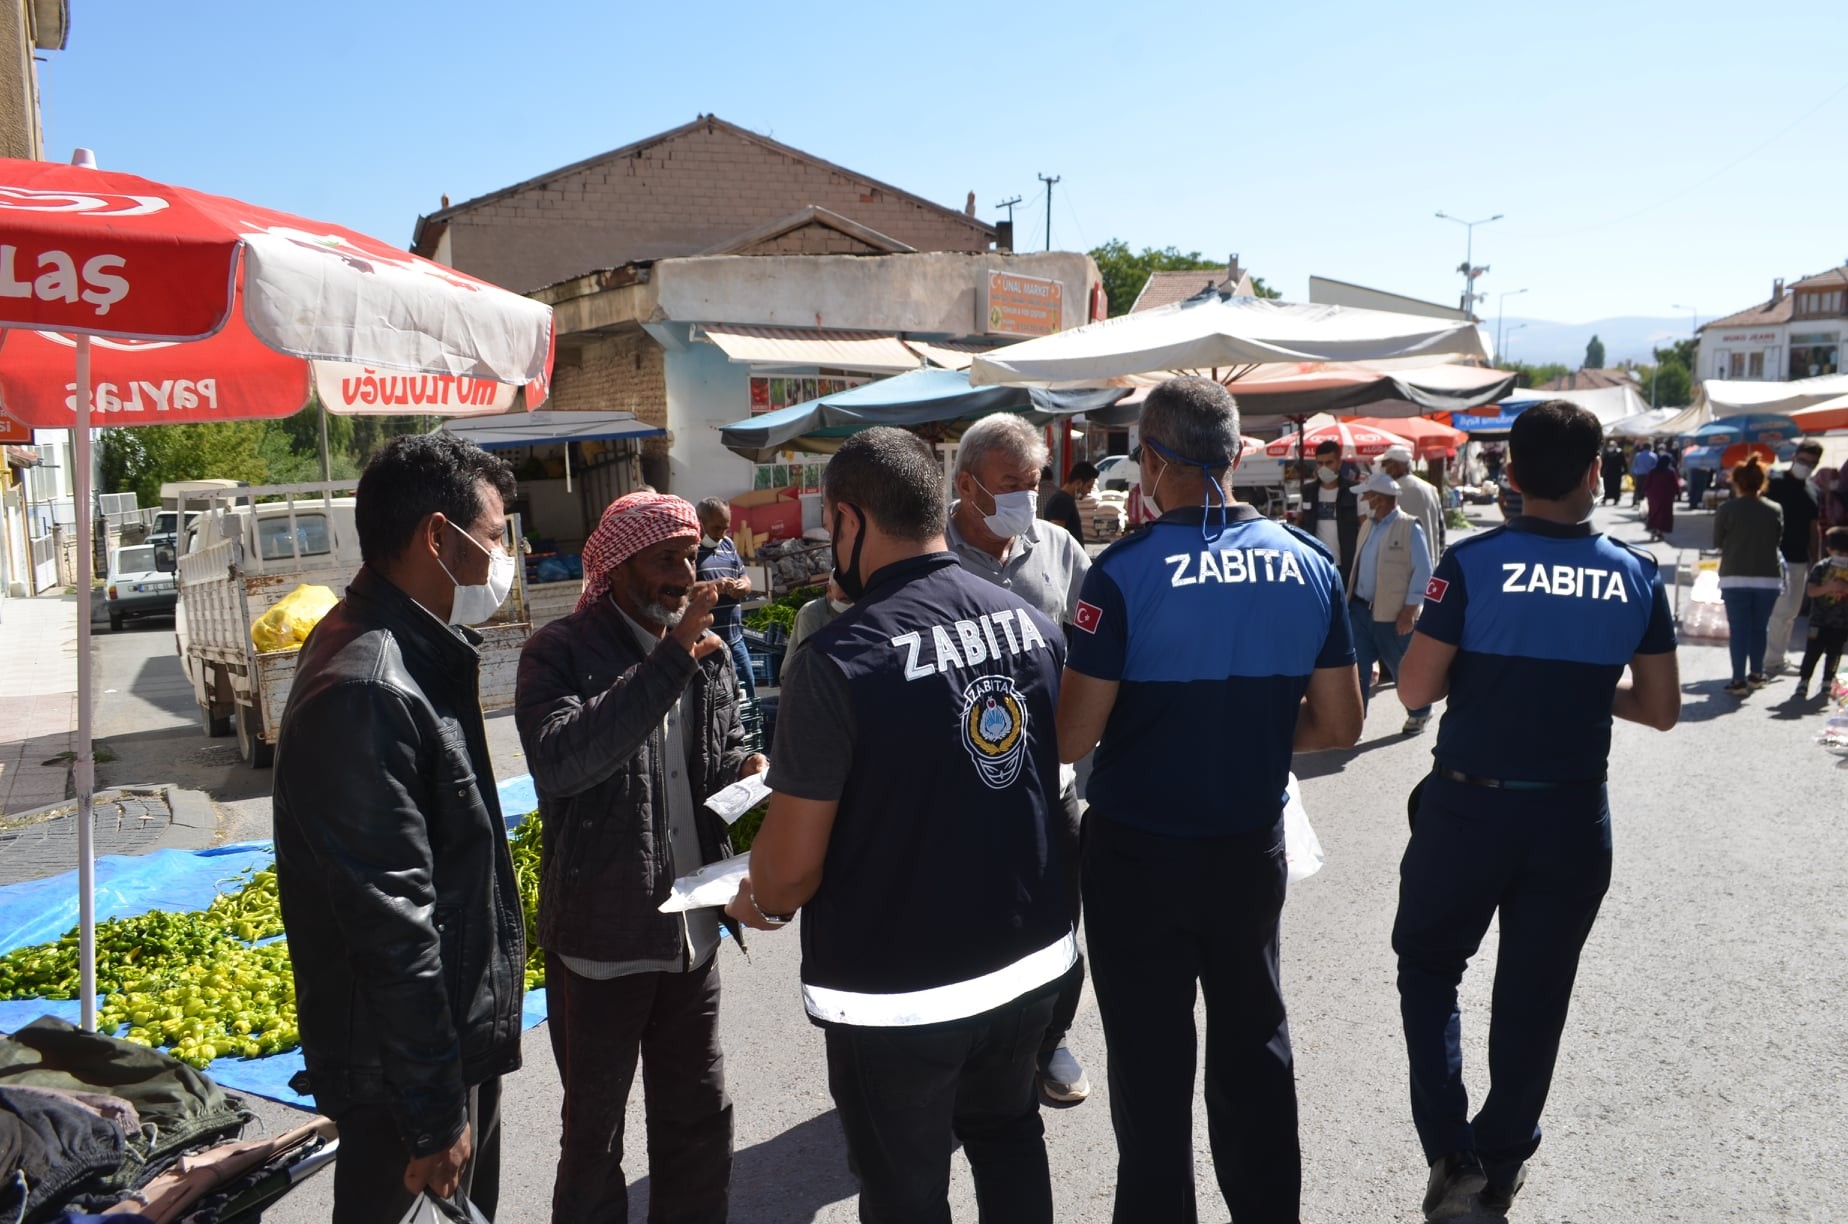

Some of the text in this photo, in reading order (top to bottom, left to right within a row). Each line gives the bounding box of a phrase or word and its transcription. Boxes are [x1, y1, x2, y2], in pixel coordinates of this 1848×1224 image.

[1024, 282, 1049, 298] MARKET
[1165, 548, 1305, 587] ZABITA
[1502, 563, 1628, 603] ZABITA
[891, 608, 1046, 682] ZABITA
[968, 679, 1010, 702] ZABITA
